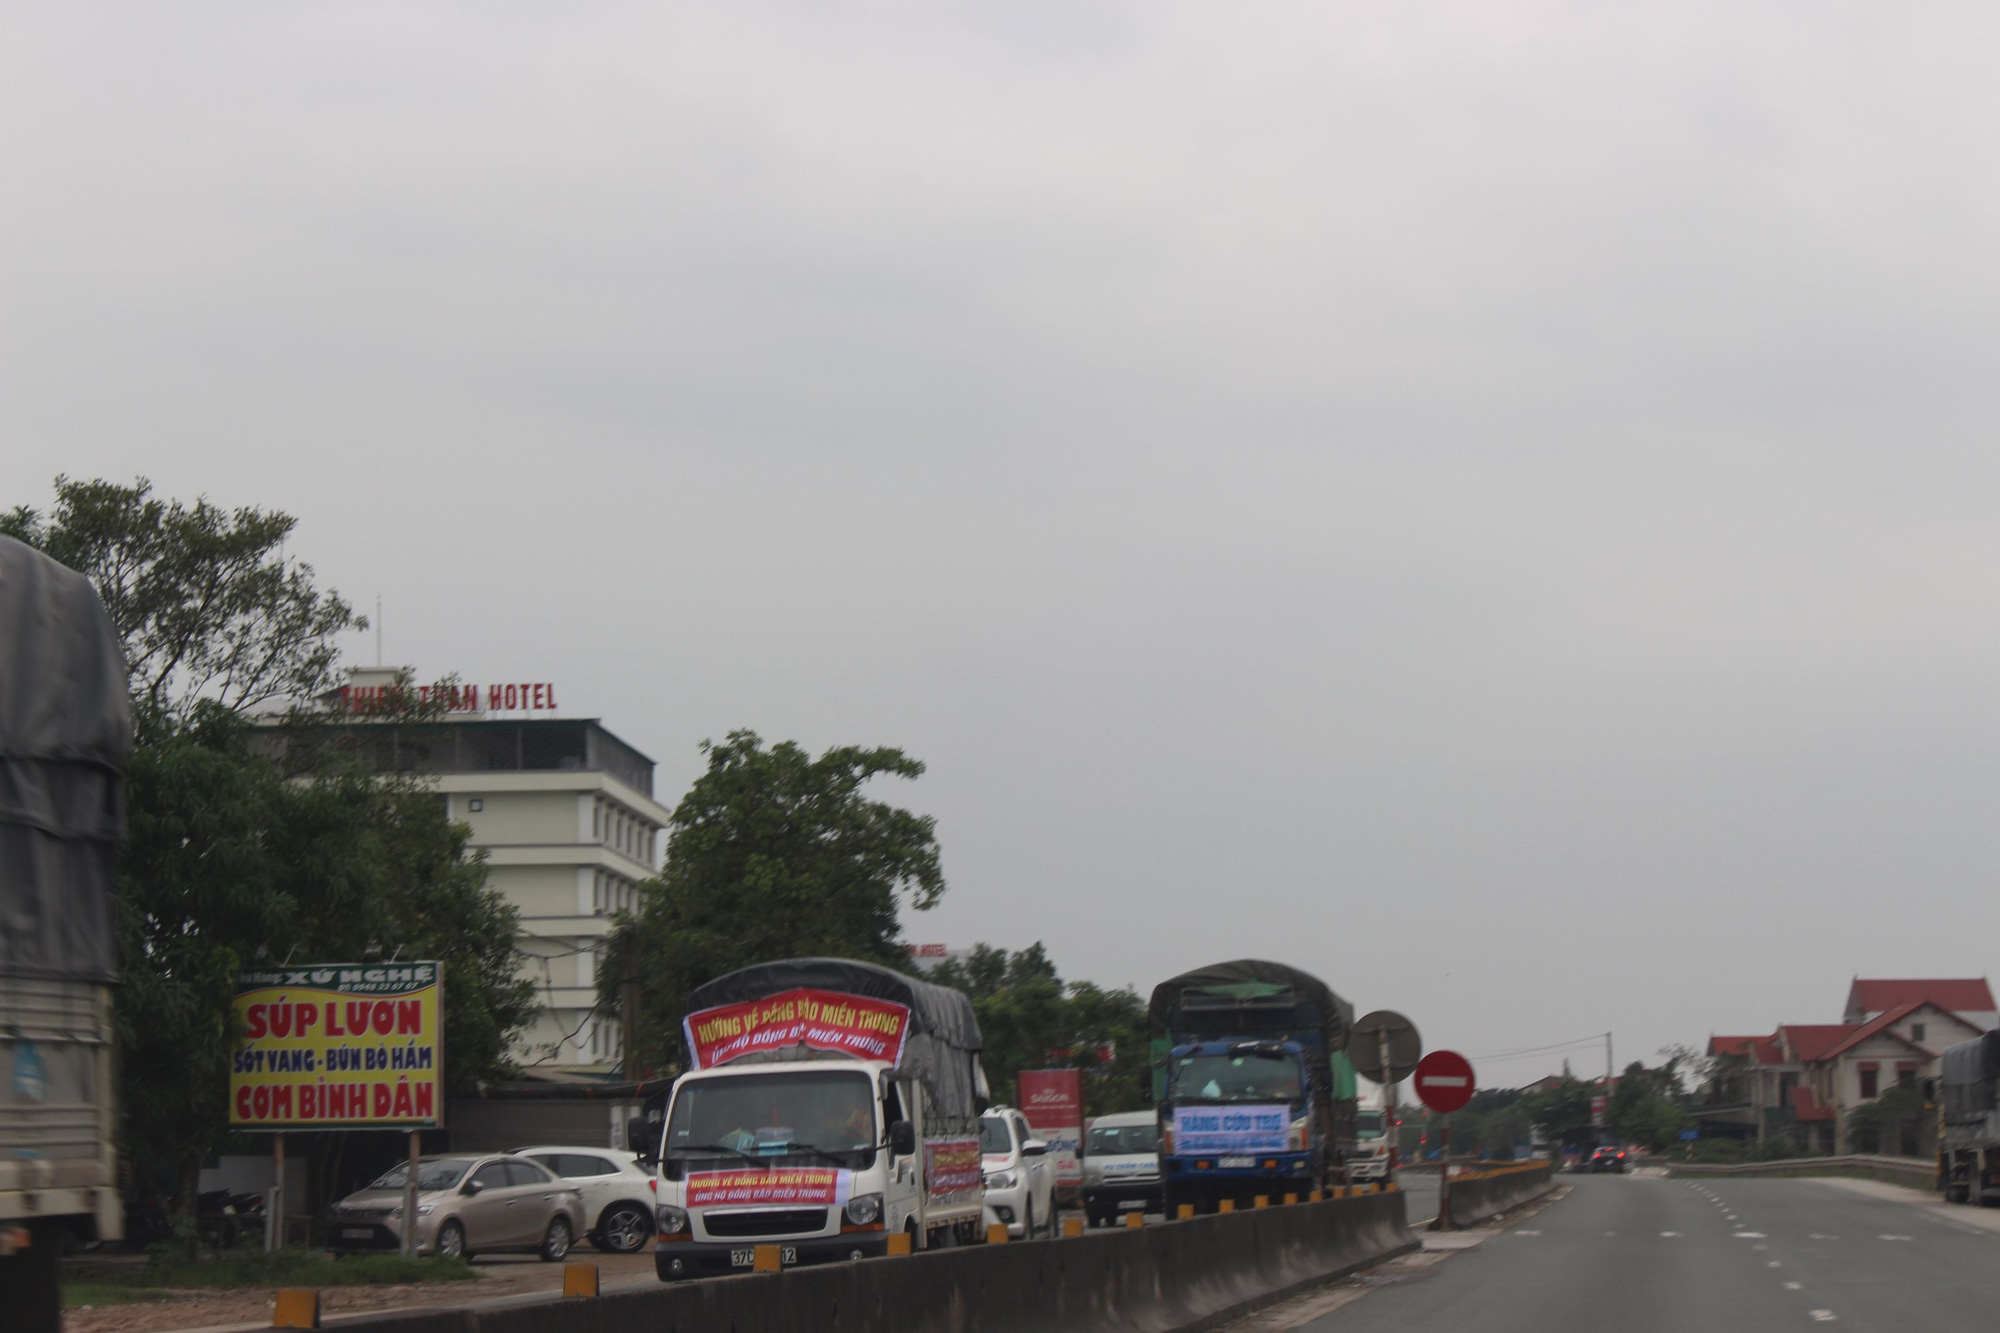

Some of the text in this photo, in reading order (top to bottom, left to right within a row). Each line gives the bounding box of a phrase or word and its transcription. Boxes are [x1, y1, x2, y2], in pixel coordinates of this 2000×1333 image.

[489, 683, 557, 710] HOTEL
[340, 965, 434, 982] NGHỆ
[246, 996, 421, 1039] SÚP LƯƠN
[858, 1010, 900, 1036] TRUNG
[266, 1049, 315, 1073] VANG
[326, 1043, 361, 1072] BÚN
[365, 1043, 388, 1071] BÒ
[844, 1035, 886, 1056] TRUNG
[236, 1075, 433, 1120] CƠM BÌNH DÂN
[804, 1173, 833, 1185] TRUNG
[797, 1187, 828, 1199] TRUNG
